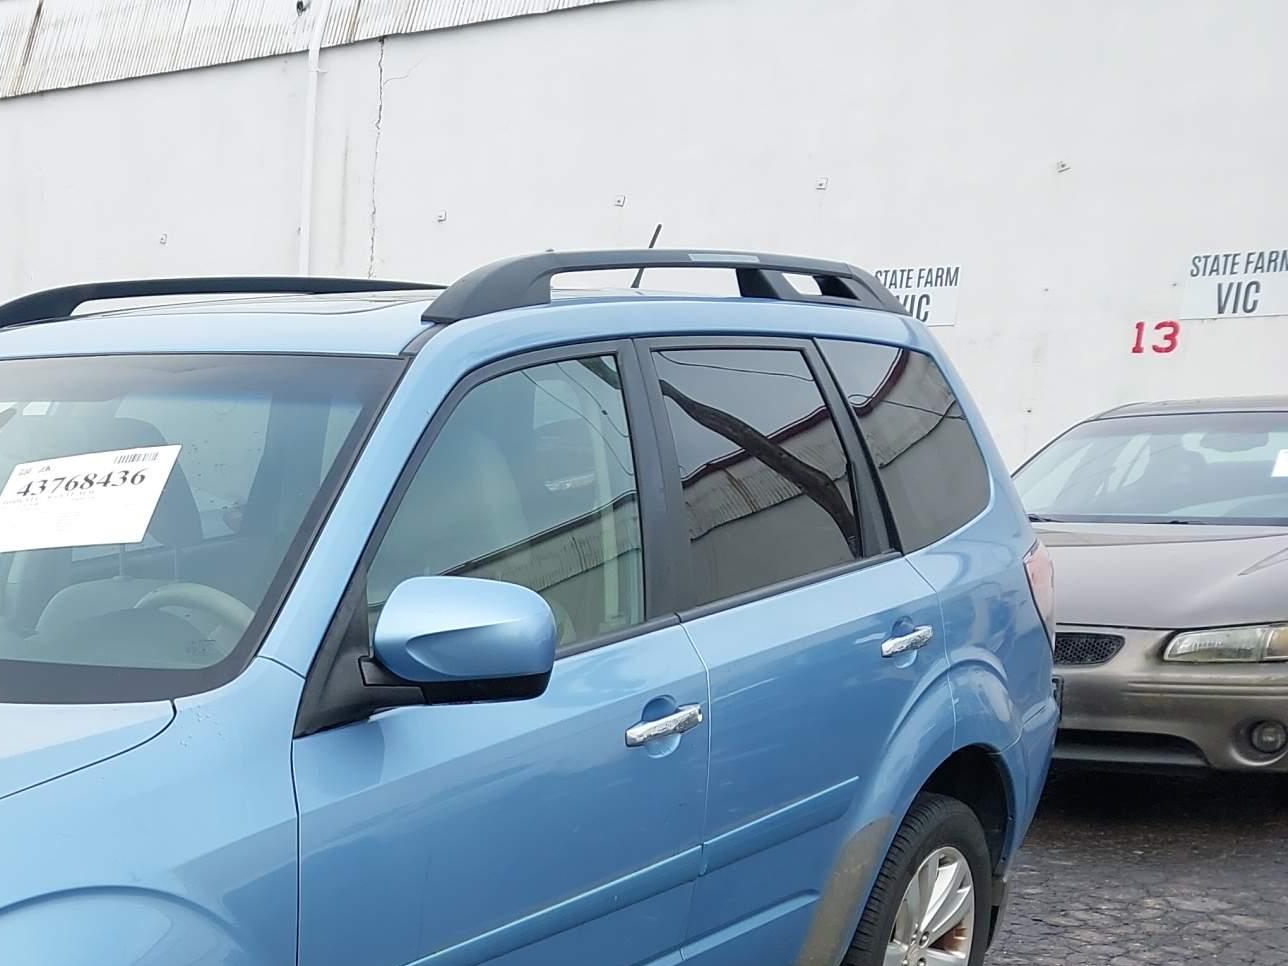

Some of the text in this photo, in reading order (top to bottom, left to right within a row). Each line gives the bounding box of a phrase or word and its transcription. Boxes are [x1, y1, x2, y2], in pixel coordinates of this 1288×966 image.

[916, 266, 961, 288] FARM
[1190, 253, 1241, 277] STATE
[1217, 281, 1261, 314] VIC
[1130, 321, 1180, 354] 13
[16, 467, 150, 497] 43768436
